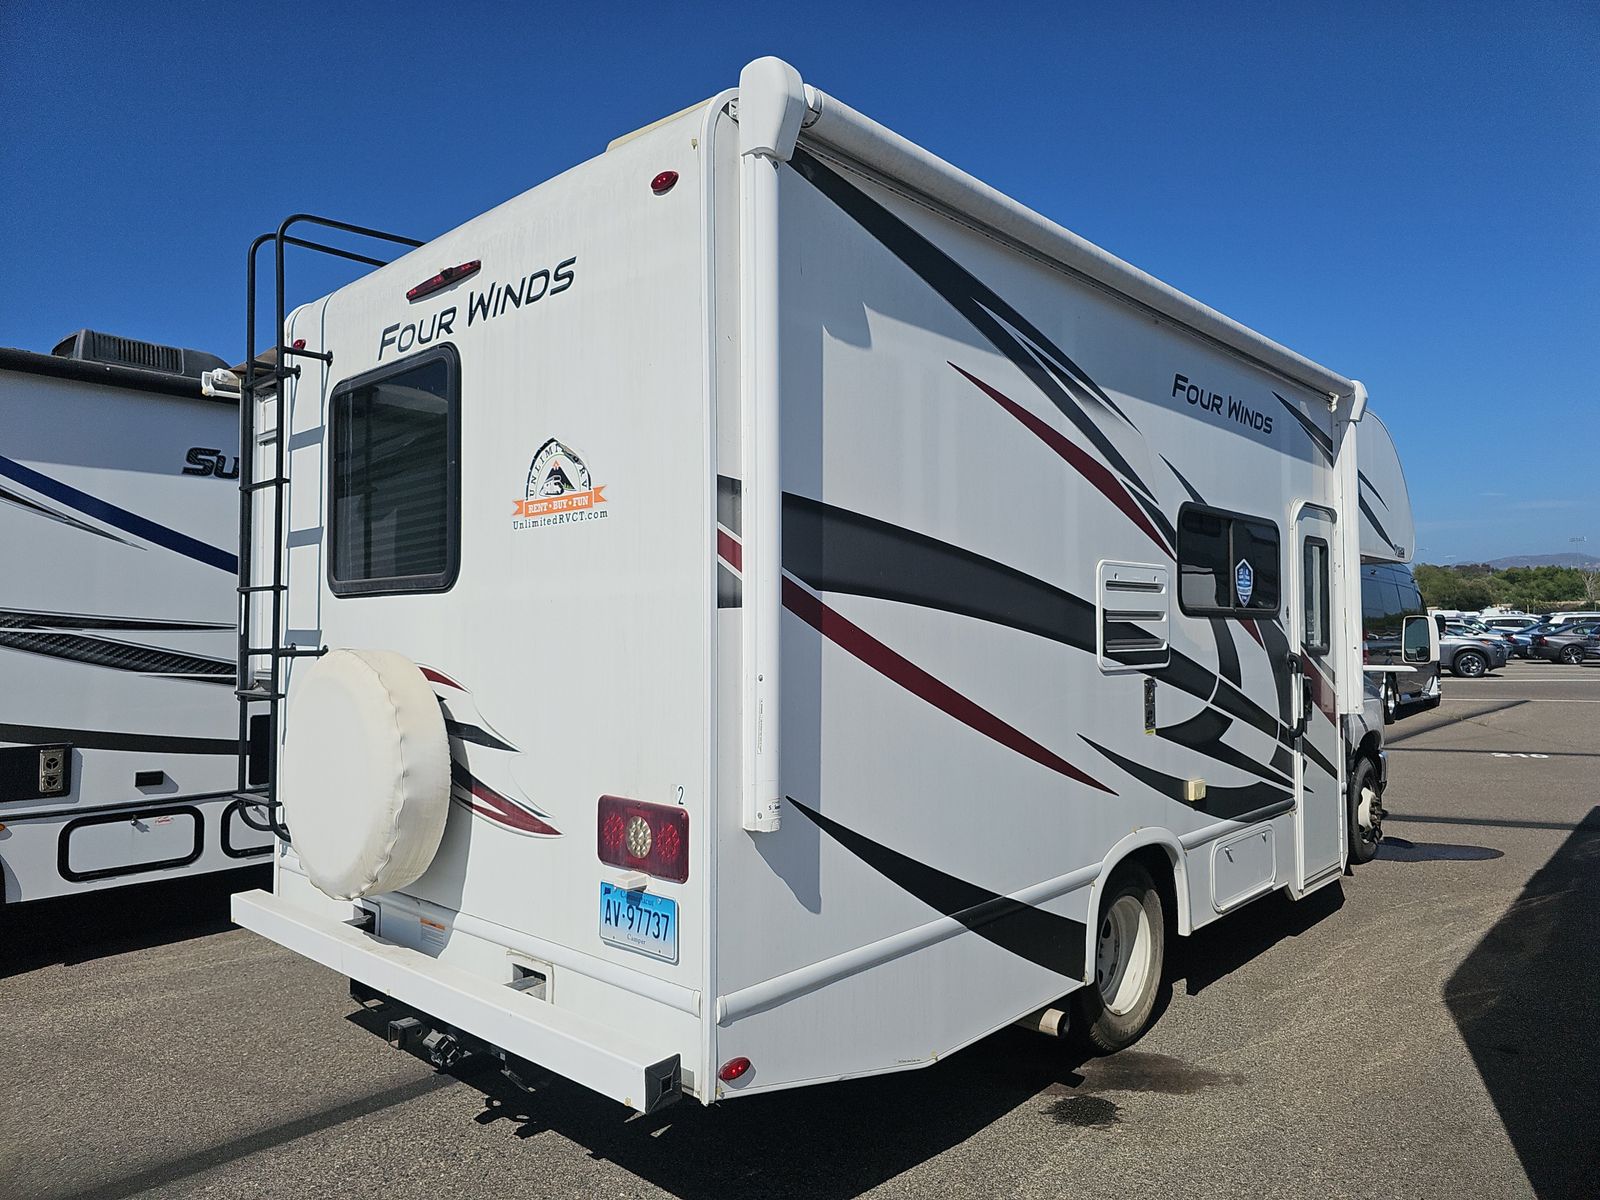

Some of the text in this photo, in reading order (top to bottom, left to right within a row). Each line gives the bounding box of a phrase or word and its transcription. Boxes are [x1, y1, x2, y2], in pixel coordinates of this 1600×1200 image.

[378, 256, 577, 361] FOUR WINDS
[1171, 373, 1273, 434] FOUR WINDS
[513, 509, 608, 531] UnlimitedRVCT.com
[677, 785, 684, 805] 2
